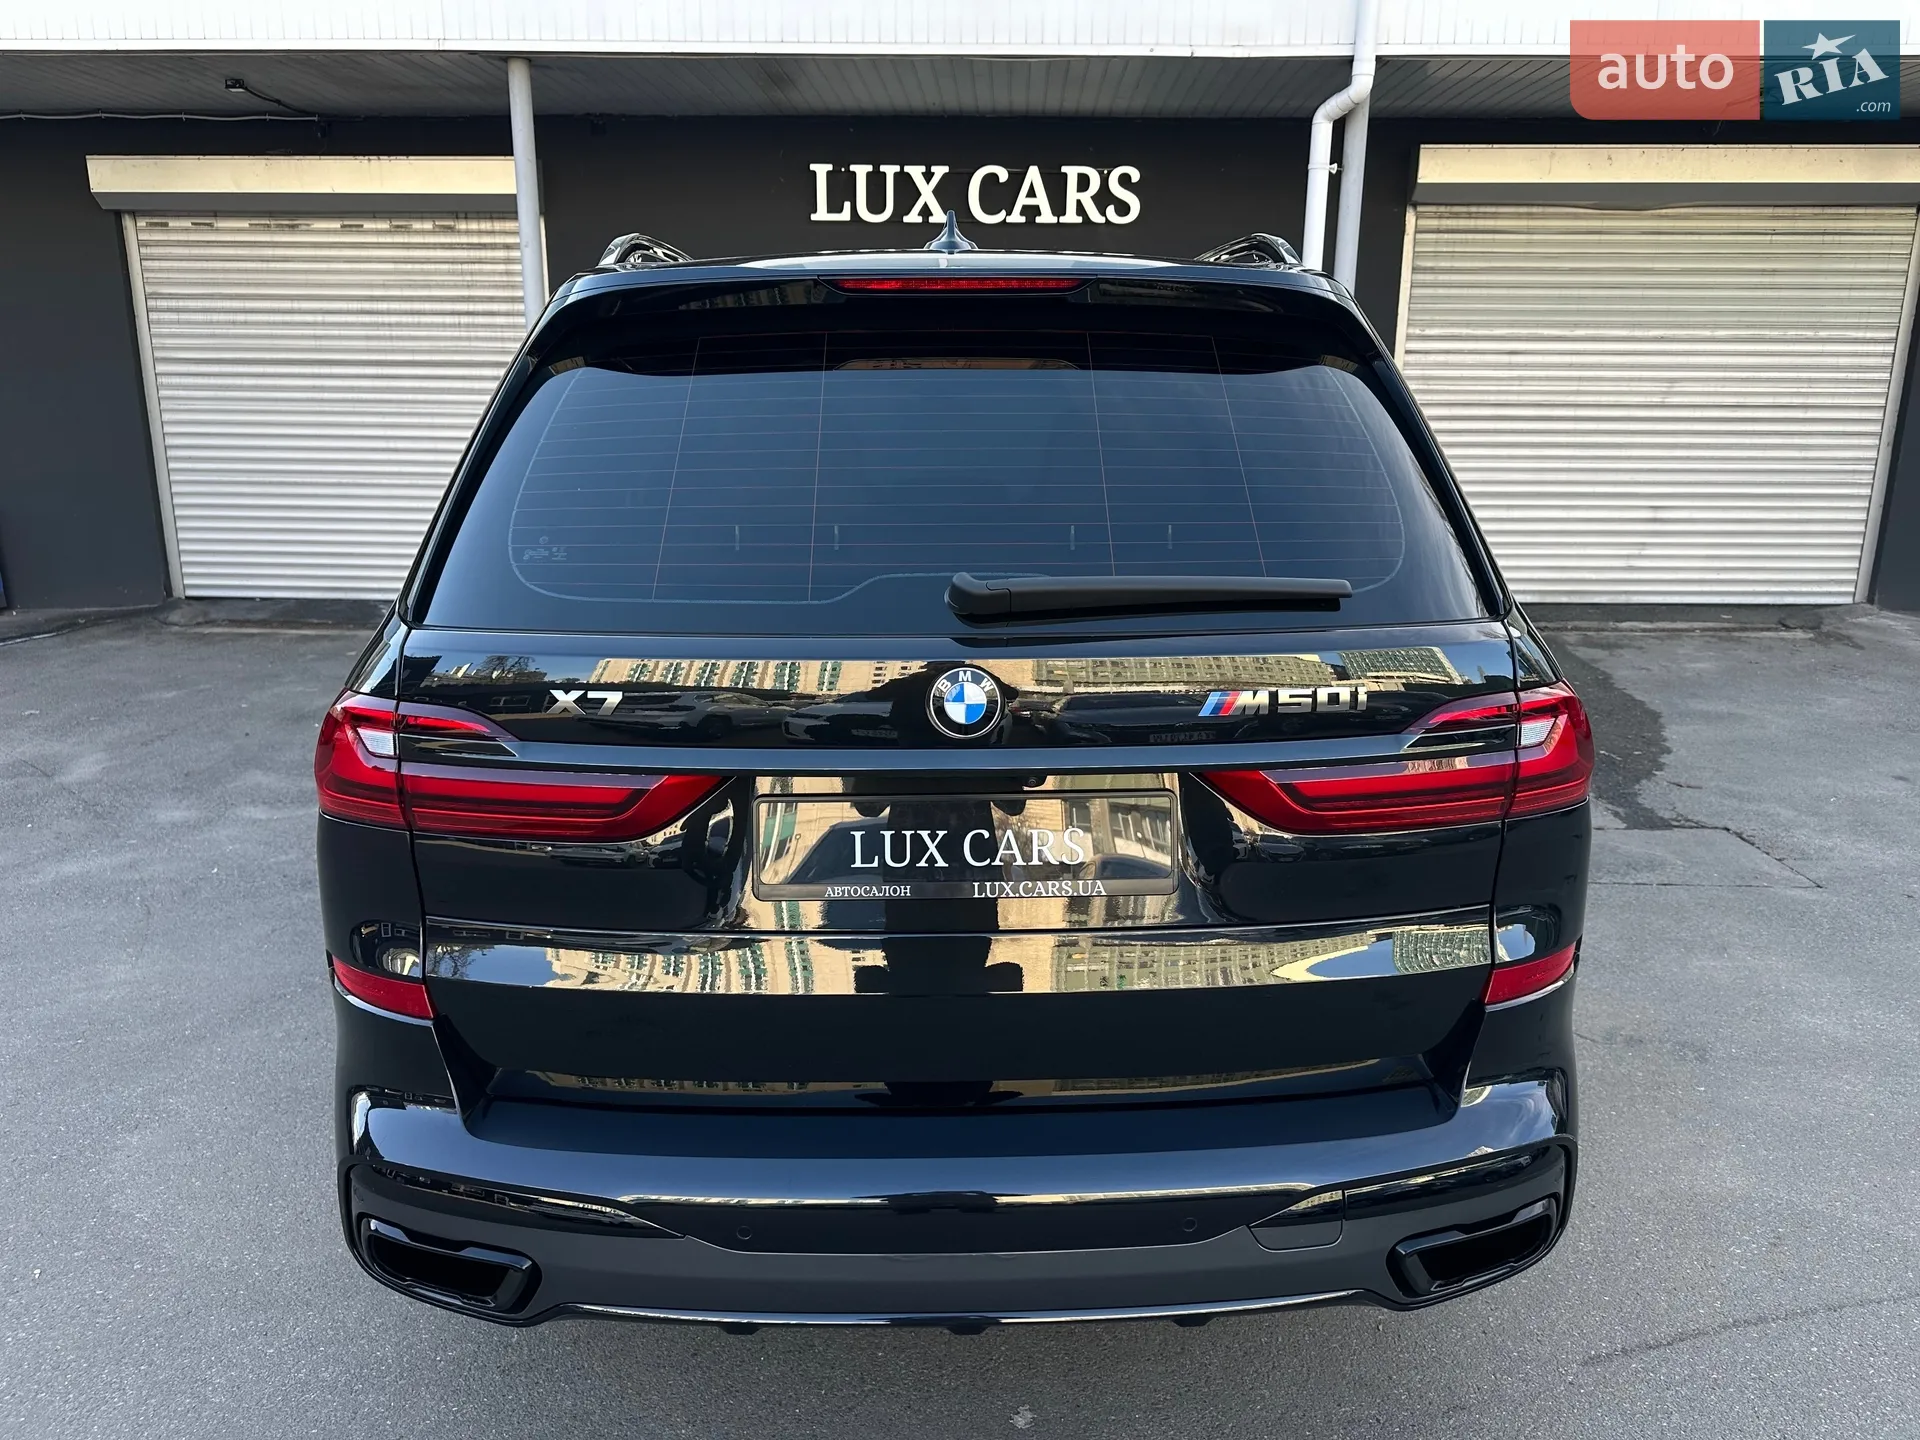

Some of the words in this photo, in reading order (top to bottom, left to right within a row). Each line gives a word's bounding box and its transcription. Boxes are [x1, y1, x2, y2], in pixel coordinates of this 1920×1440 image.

[809, 163, 949, 223] LUX
[967, 164, 1141, 224] CARS
[937, 670, 994, 693] BMW
[546, 689, 623, 716] X7
[850, 830, 949, 868] LUX
[963, 827, 1084, 867] CARS
[824, 886, 911, 898] АВТОСАЛОН
[972, 880, 1107, 898] LUX.CARS.UA
